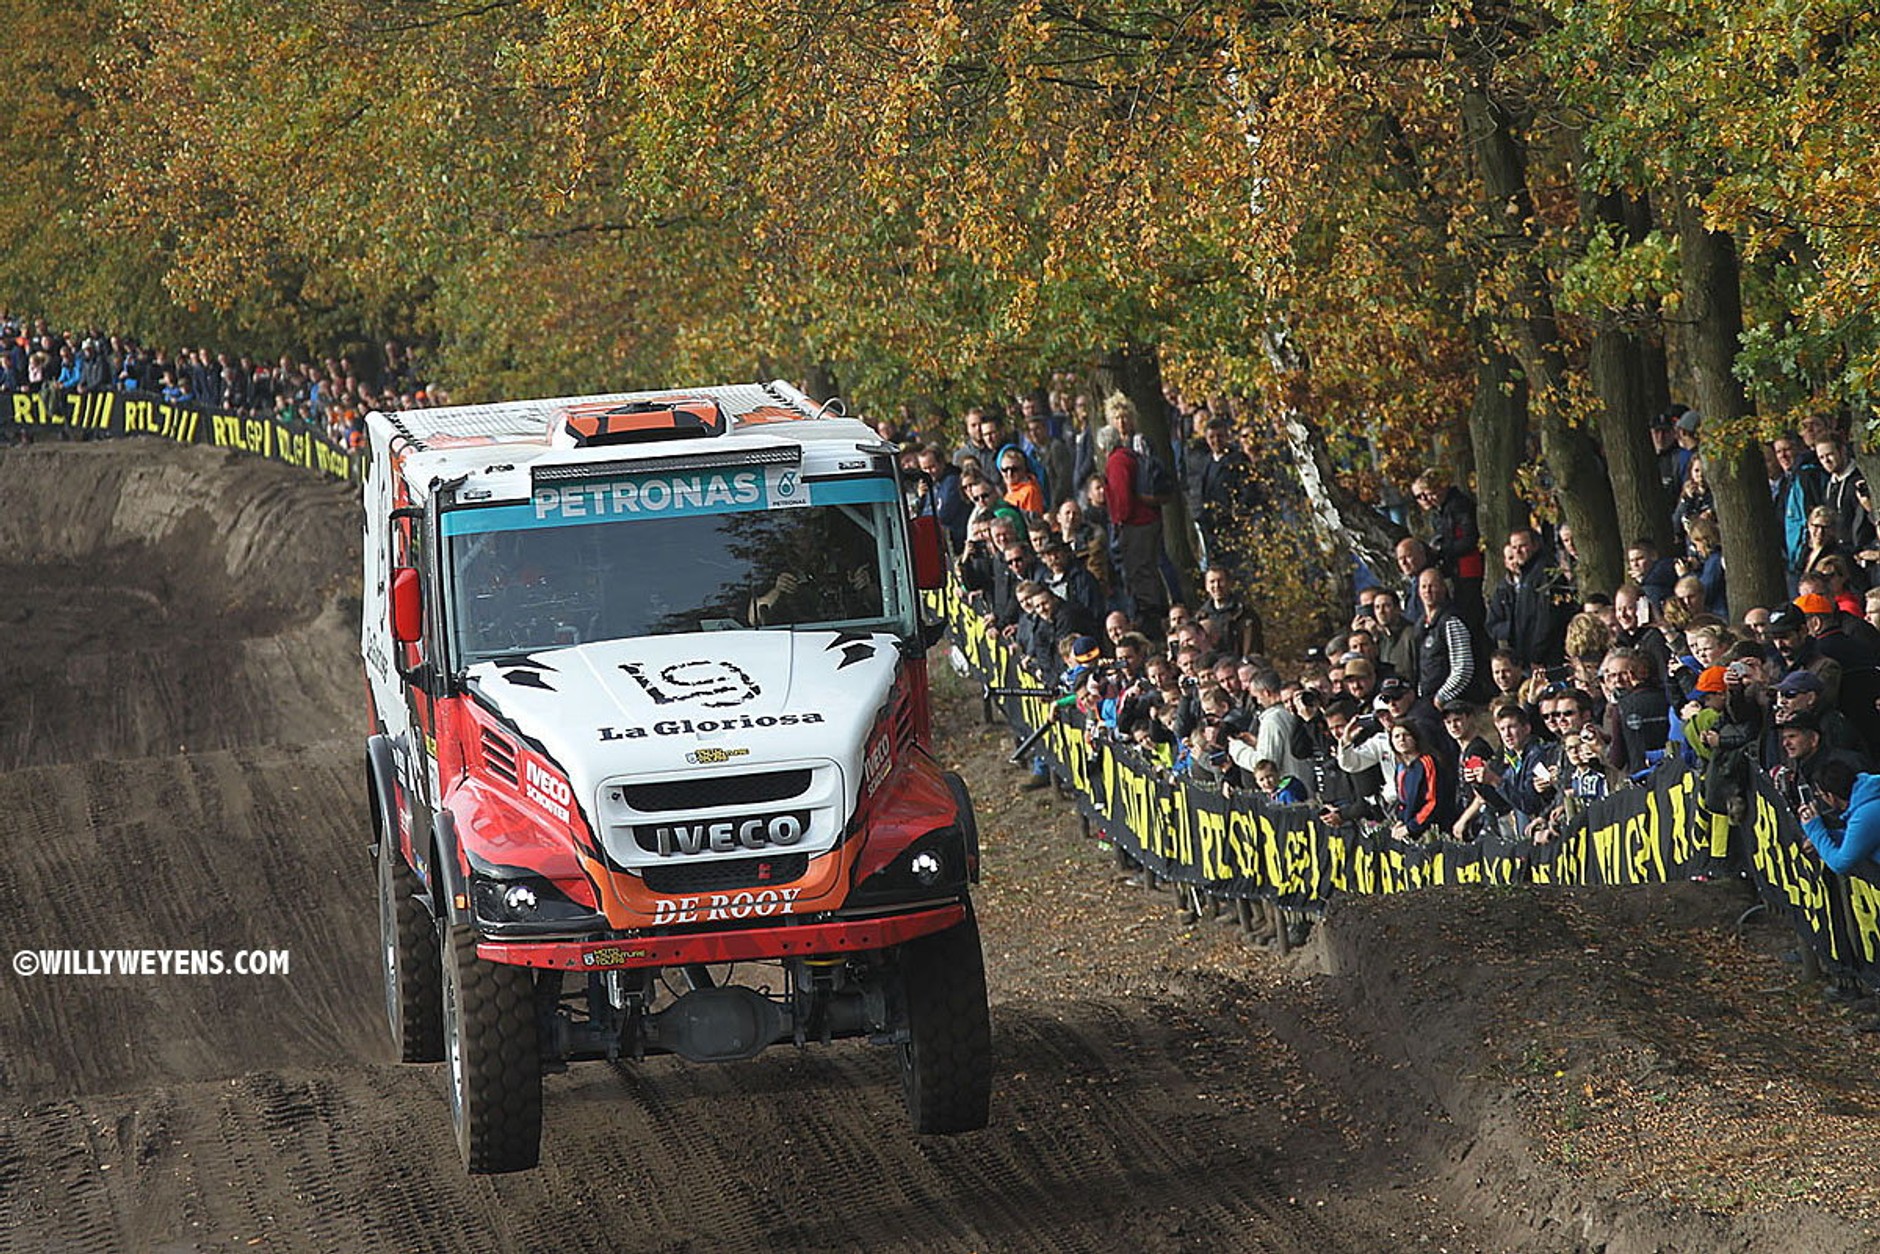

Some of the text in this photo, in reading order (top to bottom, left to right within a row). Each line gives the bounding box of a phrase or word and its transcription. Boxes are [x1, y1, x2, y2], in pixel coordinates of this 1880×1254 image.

[535, 471, 760, 520] PETRONAS
[599, 712, 825, 742] La Gloriosa
[864, 733, 890, 782] IVECO
[526, 759, 570, 807] IVECO
[656, 815, 801, 856] IVECO
[652, 888, 802, 926] DE ROOY
